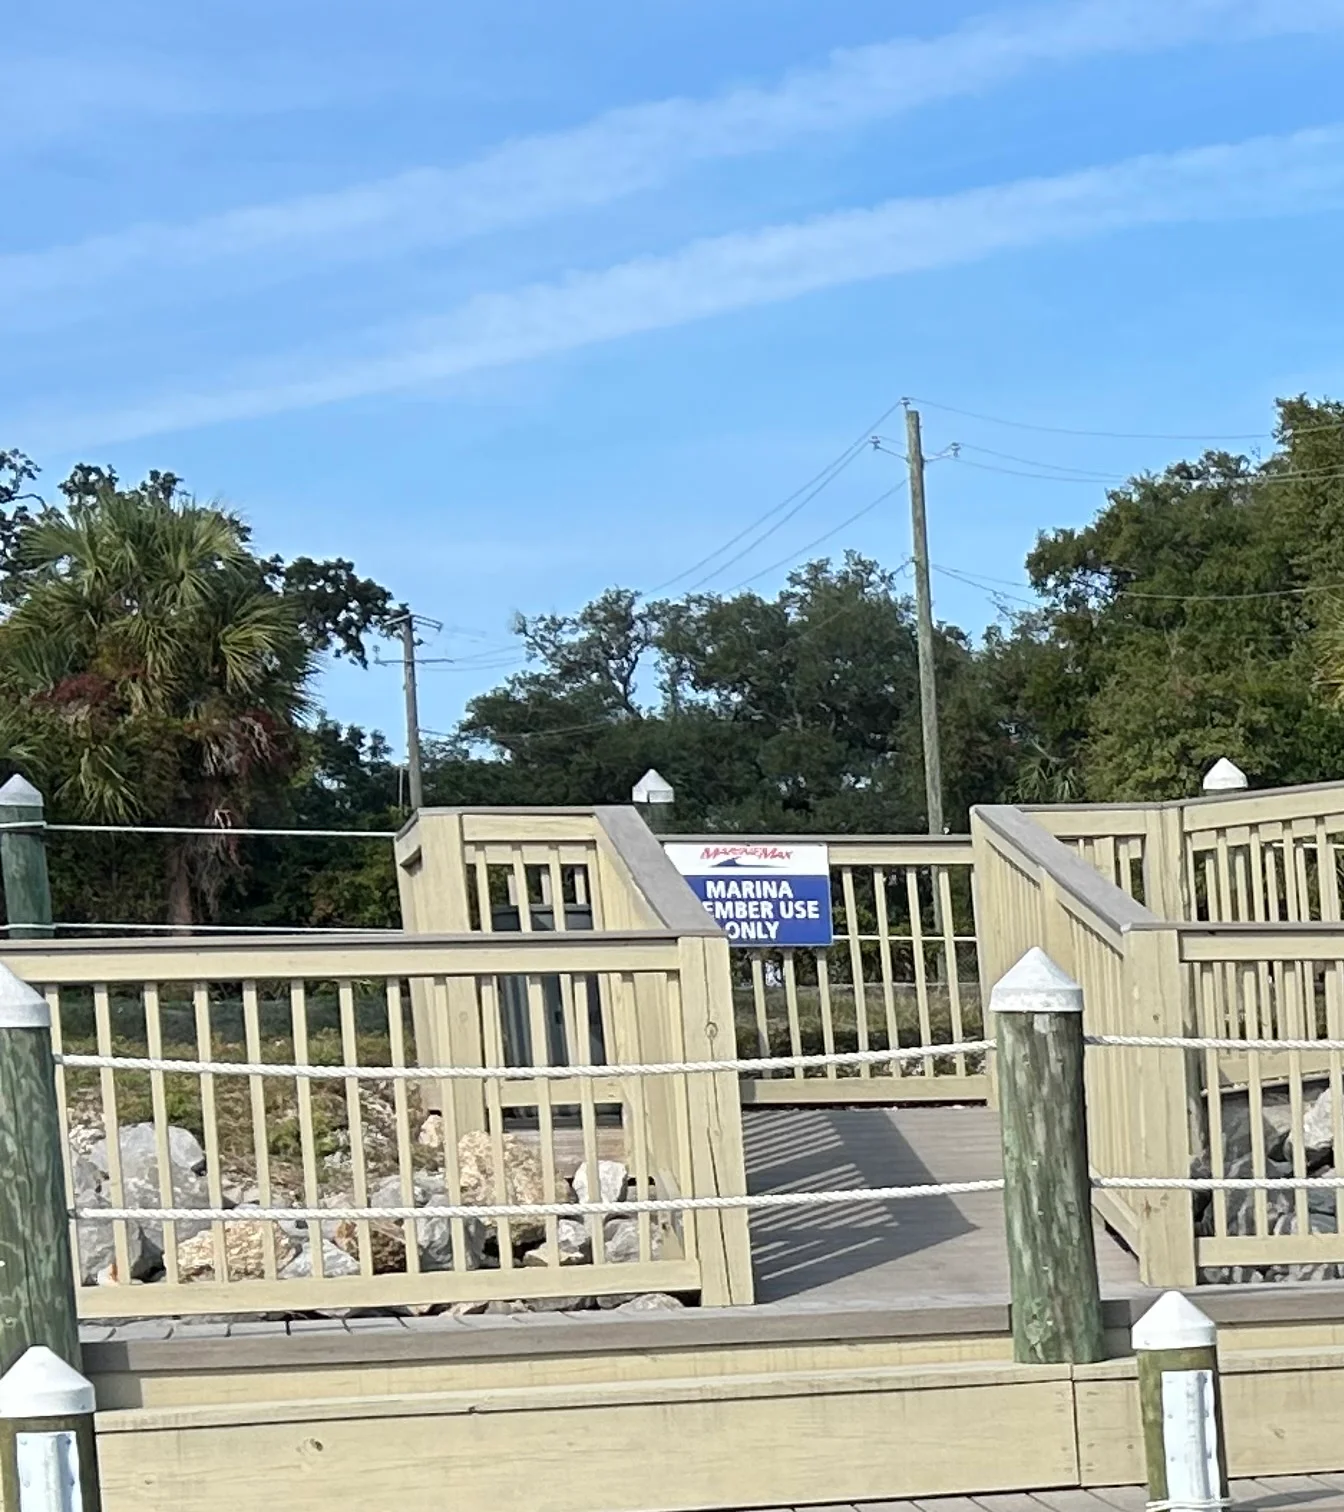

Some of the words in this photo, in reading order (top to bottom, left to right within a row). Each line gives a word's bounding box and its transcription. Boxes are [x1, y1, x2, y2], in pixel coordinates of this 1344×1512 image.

[705, 880, 794, 899] MARINA
[702, 900, 774, 919] EMBER
[780, 900, 820, 919] USE
[725, 920, 780, 940] ONLY
